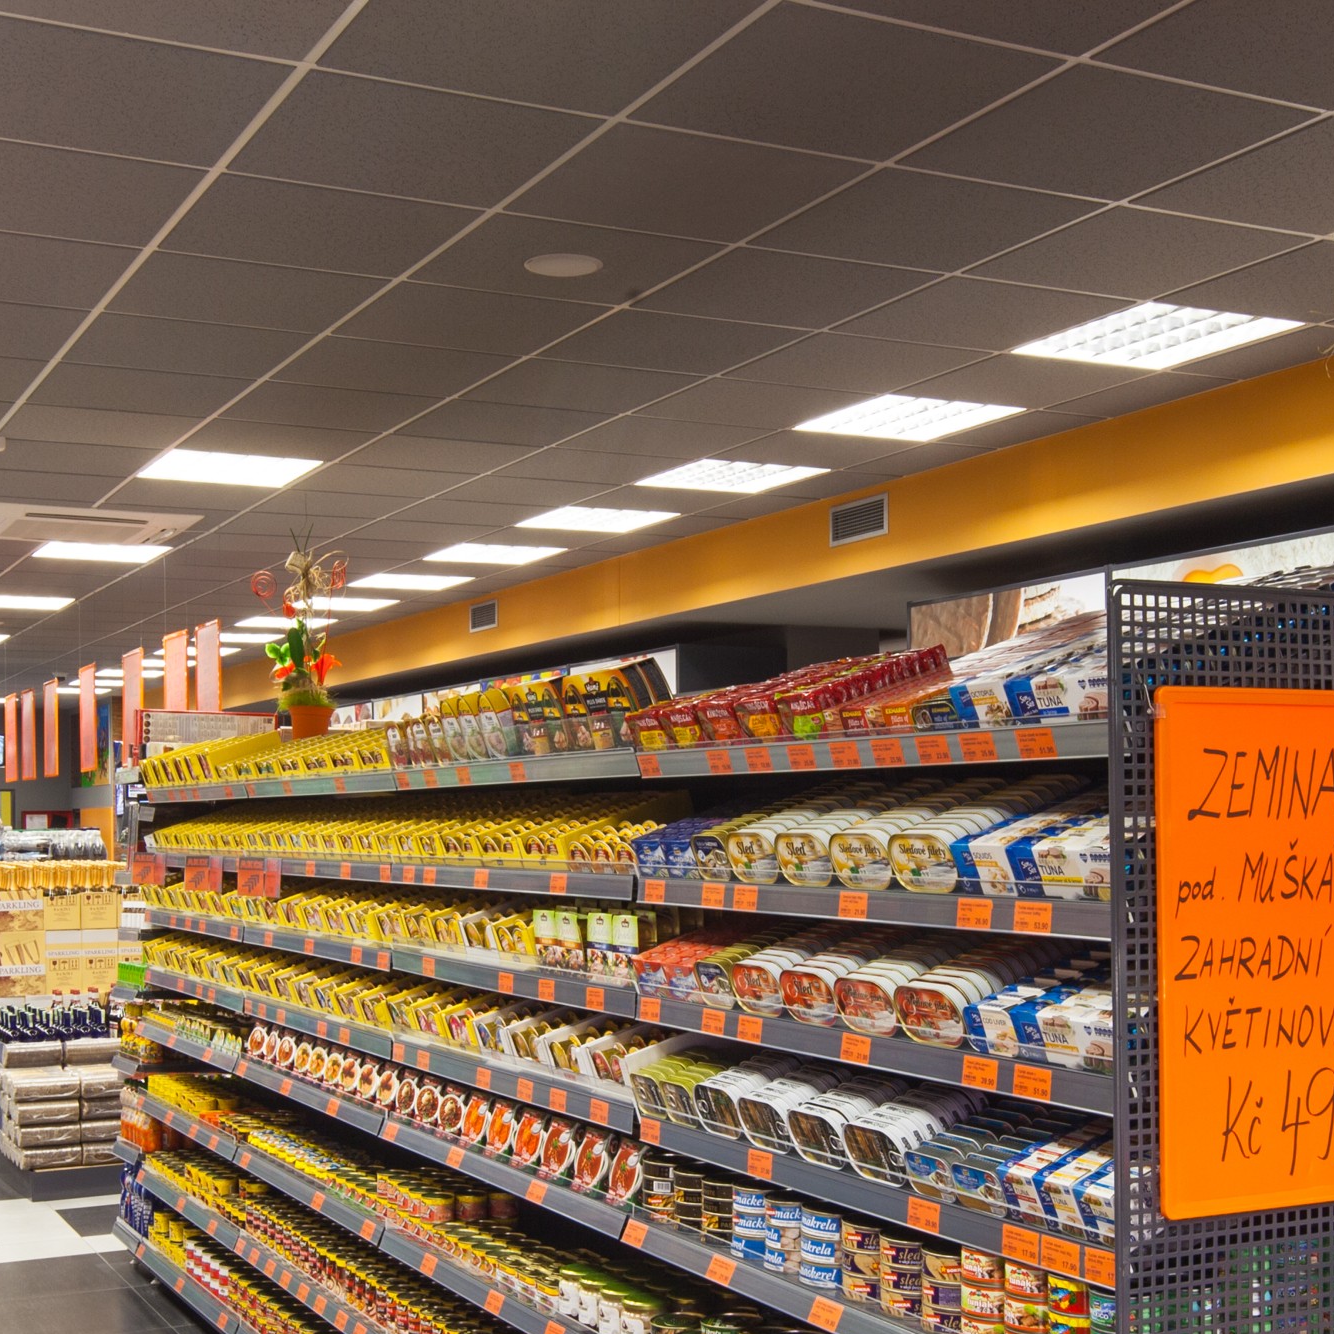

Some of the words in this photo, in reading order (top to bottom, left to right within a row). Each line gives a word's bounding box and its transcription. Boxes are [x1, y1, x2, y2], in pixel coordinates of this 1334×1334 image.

[970, 689, 995, 699] OCTOPUS
[1037, 695, 1063, 708] TUNA
[973, 852, 993, 860] SQUIDS
[1039, 864, 1065, 876] TUNA
[1174, 924, 1332, 982] ZAHRADNÍ
[1042, 1031, 1068, 1045] TUNA
[1221, 1075, 1265, 1162] Kč
